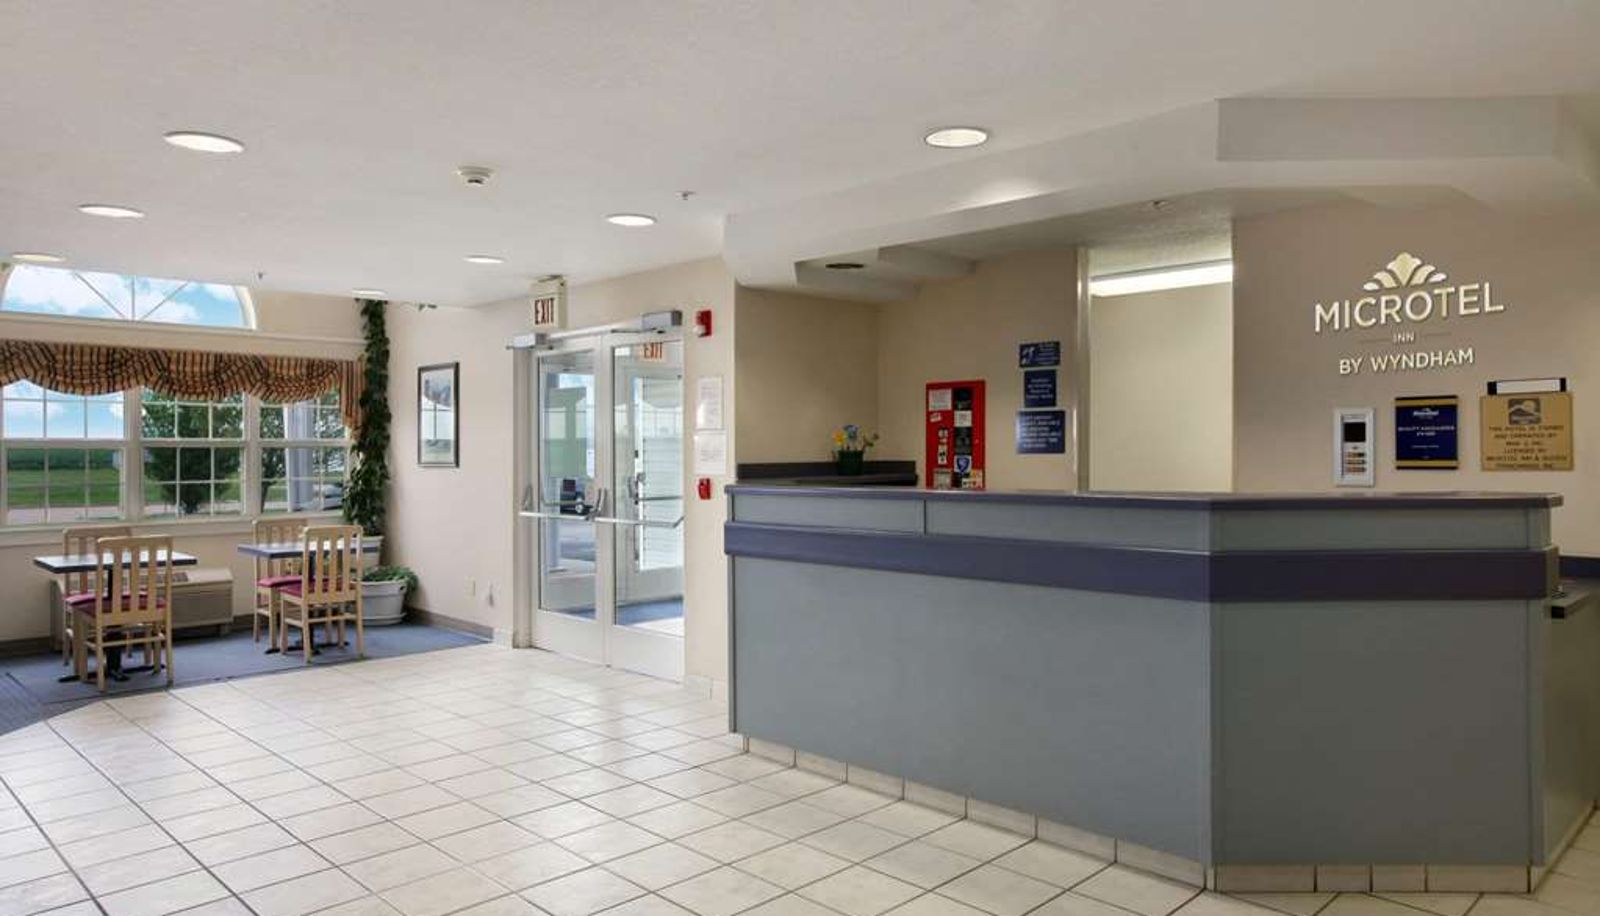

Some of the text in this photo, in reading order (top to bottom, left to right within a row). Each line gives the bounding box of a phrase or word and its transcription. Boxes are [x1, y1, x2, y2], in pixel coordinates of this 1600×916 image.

[534, 297, 555, 325] EXIT
[1314, 281, 1505, 333] MICROTEL
[643, 341, 664, 359] EXIT
[1392, 331, 1415, 344] INN
[1339, 347, 1475, 375] BY WYNDHAM
